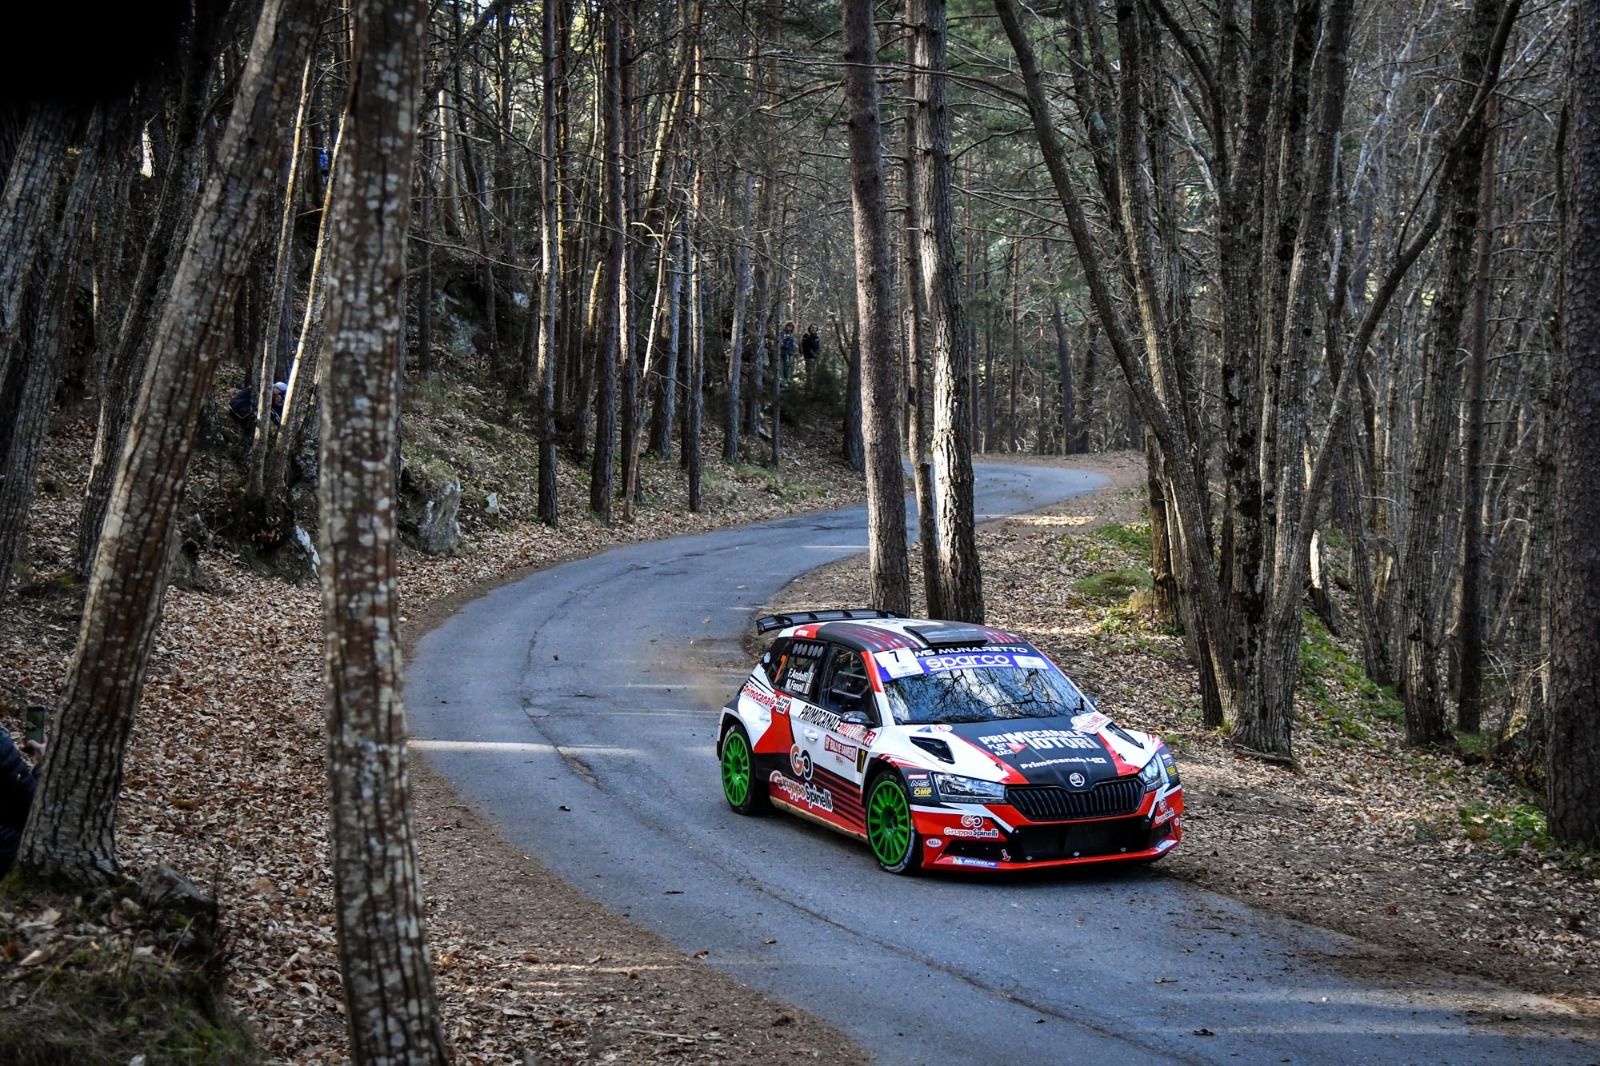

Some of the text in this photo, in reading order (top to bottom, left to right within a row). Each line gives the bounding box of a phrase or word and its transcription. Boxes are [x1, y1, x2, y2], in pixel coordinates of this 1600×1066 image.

[888, 650, 900, 663] 7
[938, 646, 1028, 654] MUNARETTO
[925, 654, 1011, 671] sparco
[742, 683, 776, 709] Primocanale
[977, 729, 1088, 745] PRIMOCANALE
[913, 787, 932, 798] OMP
[943, 826, 999, 839] GruppoSpinelli
[965, 859, 998, 868] MICHELIN
